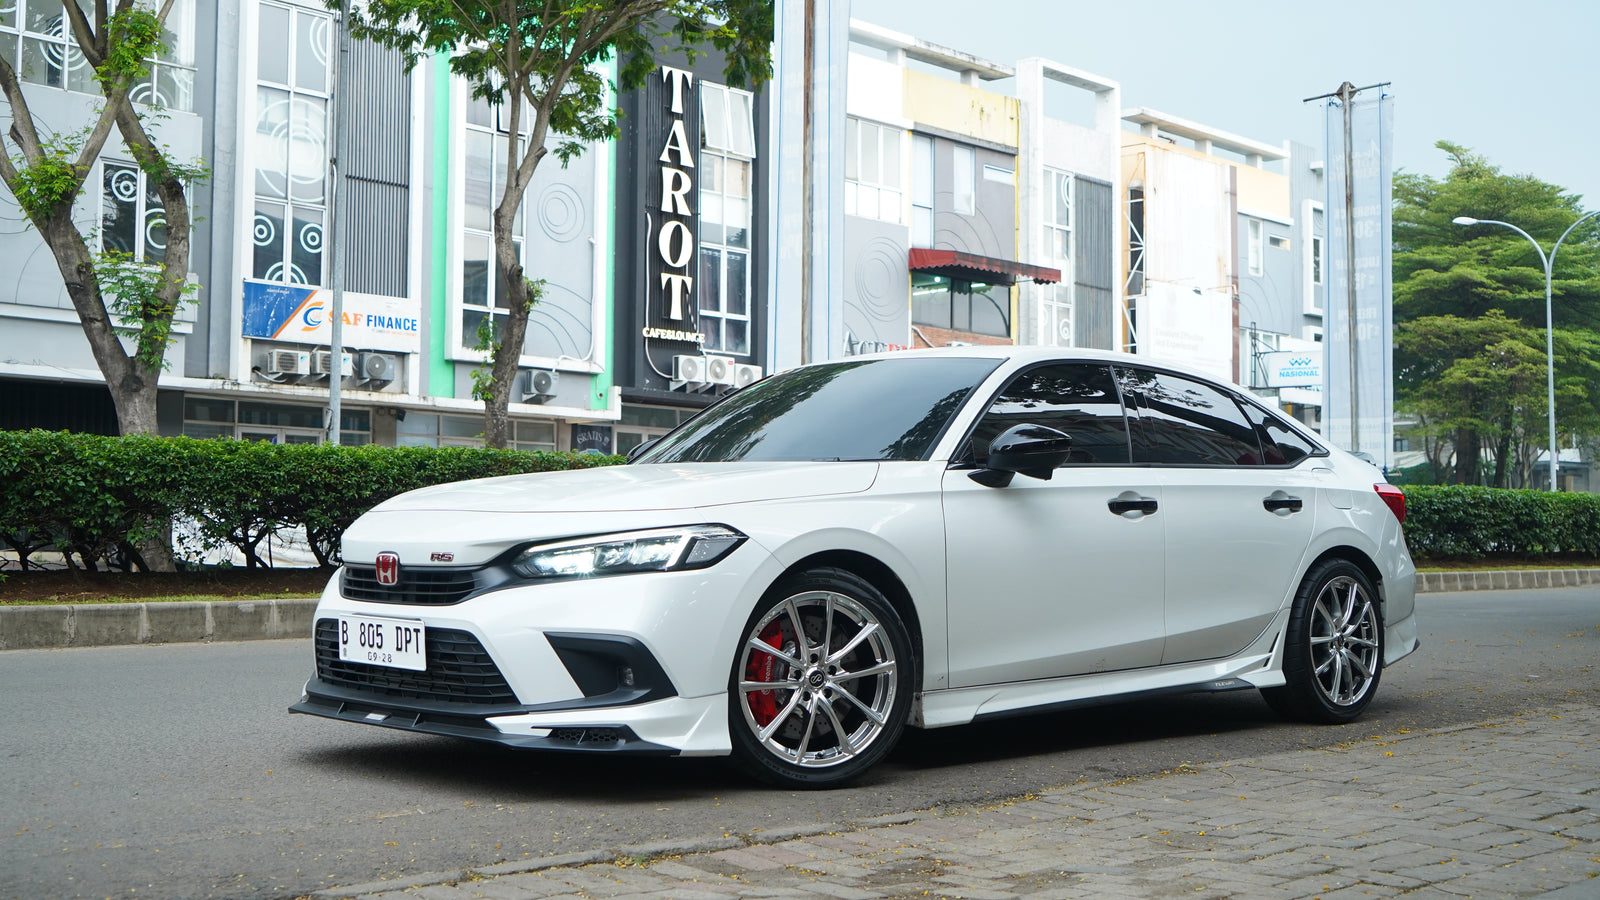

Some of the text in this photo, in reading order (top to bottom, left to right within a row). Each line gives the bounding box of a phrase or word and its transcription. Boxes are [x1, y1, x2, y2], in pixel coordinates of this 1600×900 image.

[659, 65, 694, 320] TAROT
[366, 315, 417, 331] FINANCE
[1279, 370, 1319, 378] NASIONAL
[430, 552, 454, 562] RS
[341, 620, 421, 654] B 805 DPT
